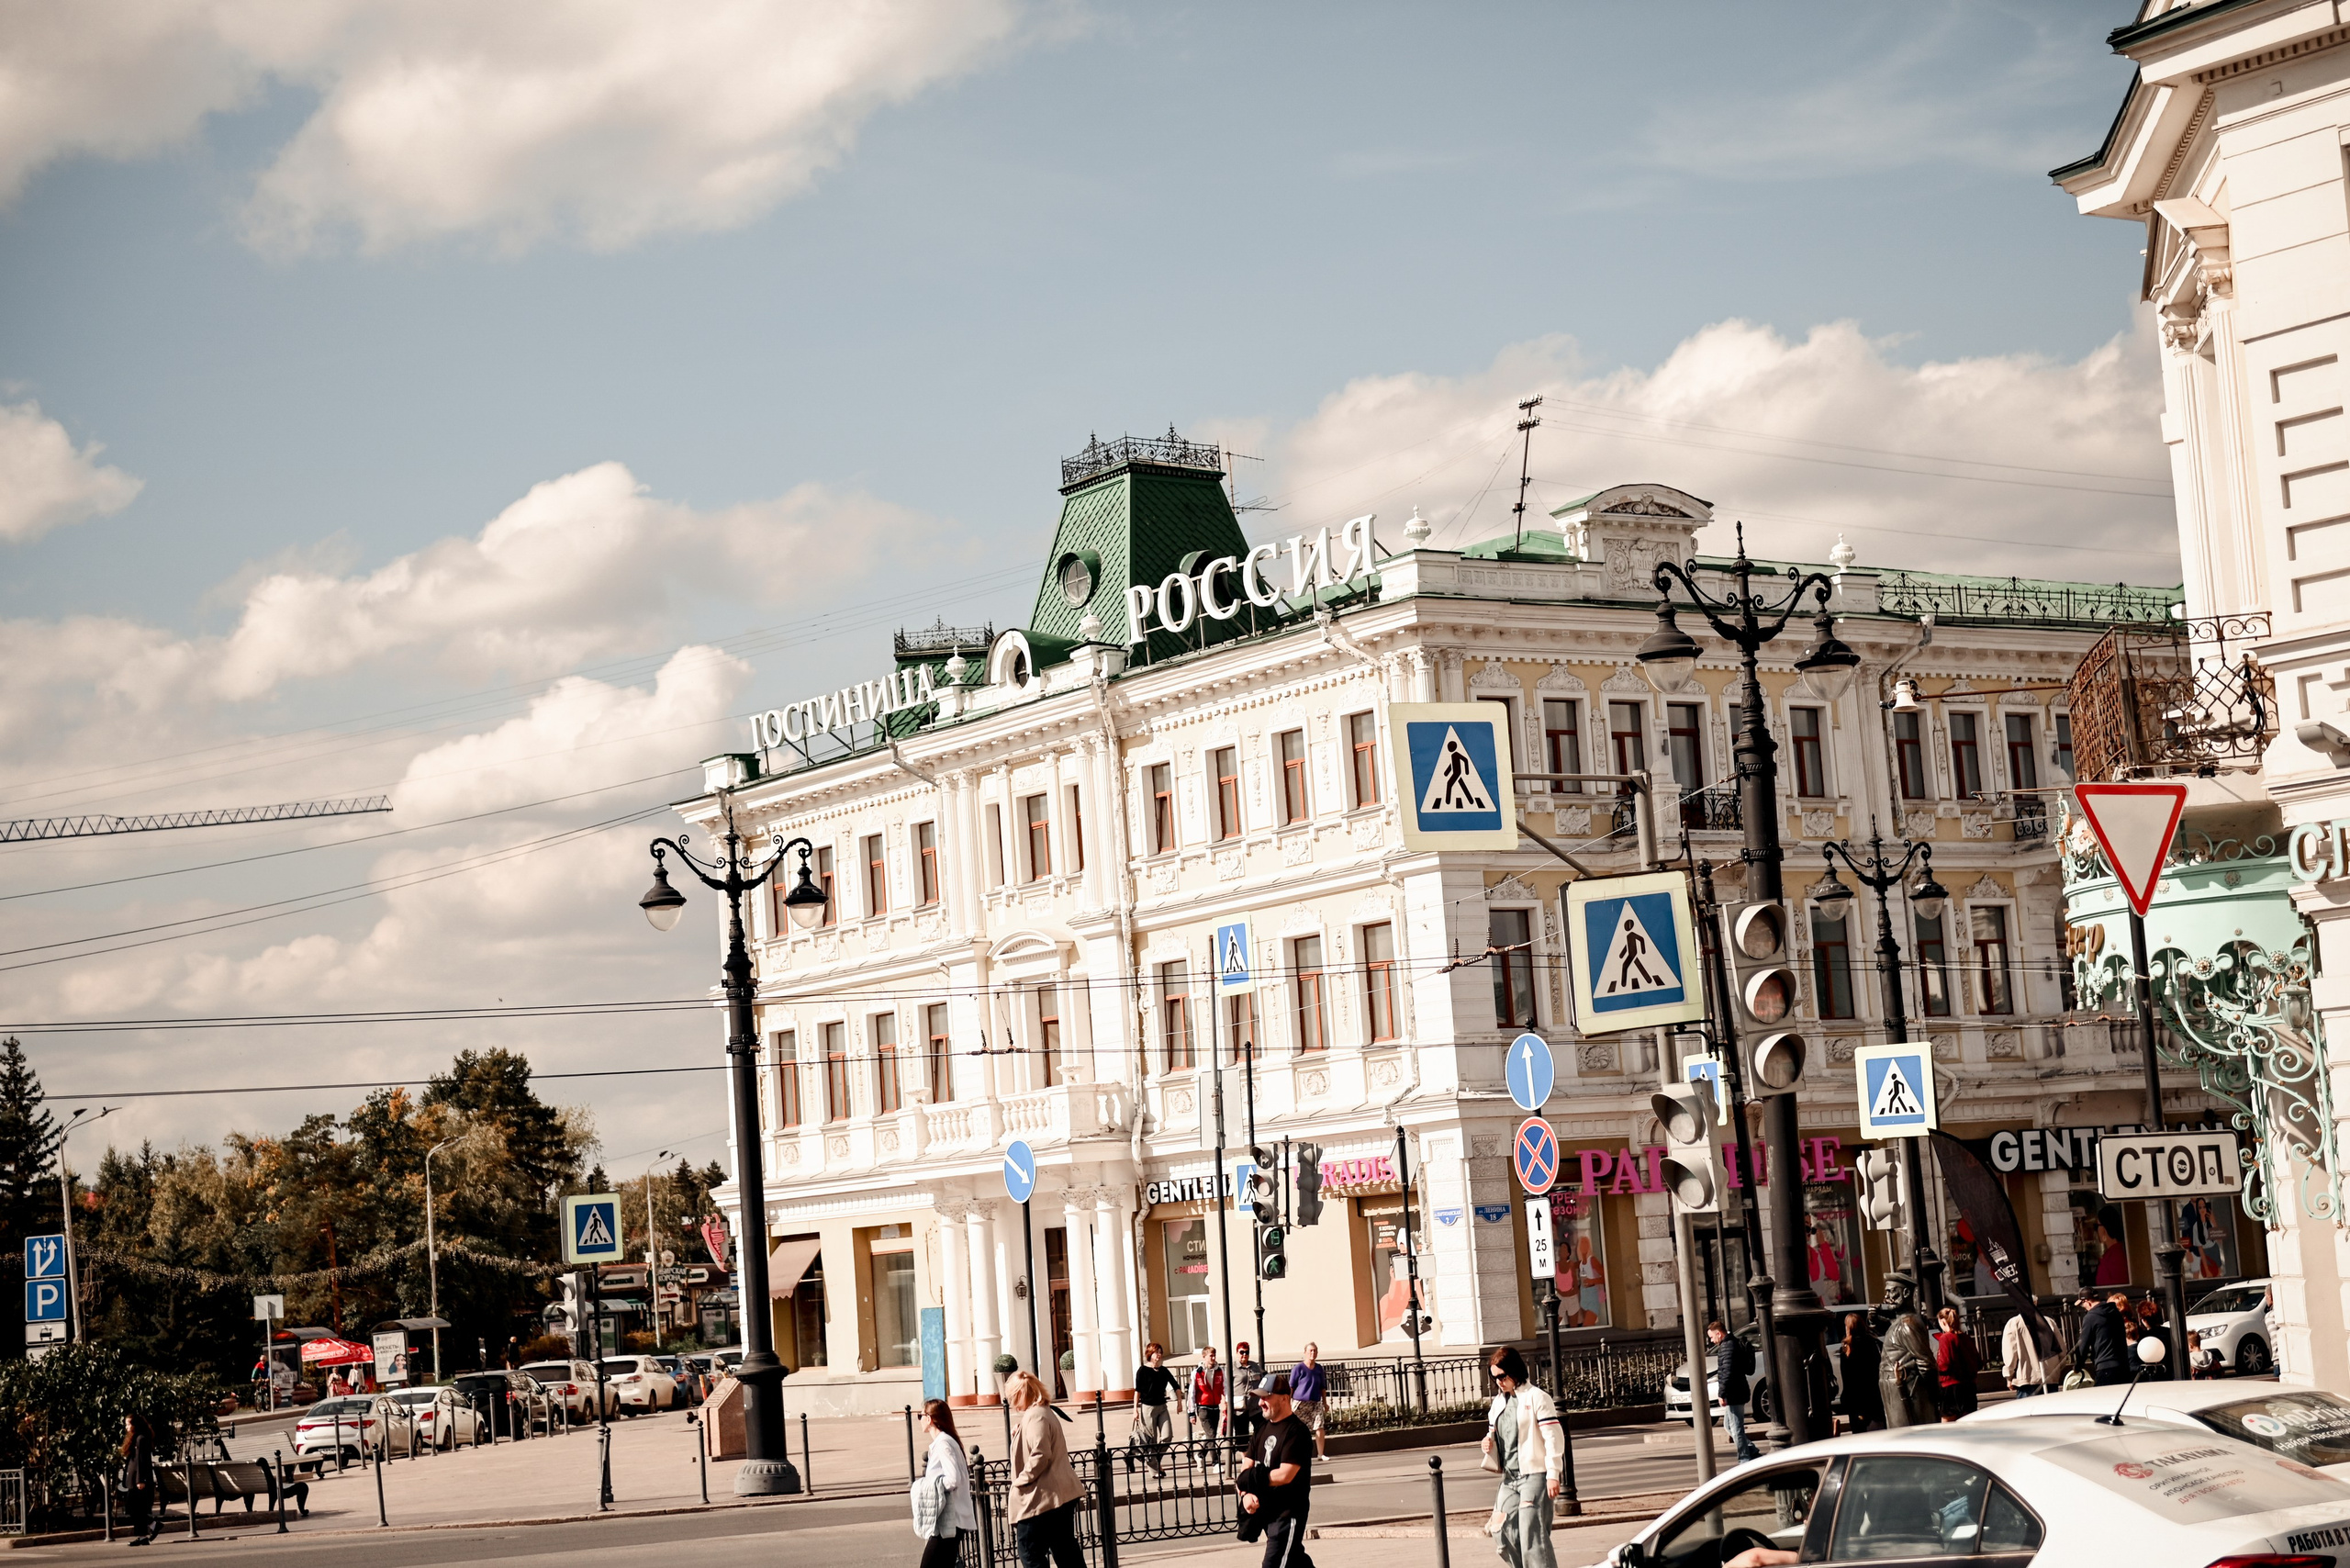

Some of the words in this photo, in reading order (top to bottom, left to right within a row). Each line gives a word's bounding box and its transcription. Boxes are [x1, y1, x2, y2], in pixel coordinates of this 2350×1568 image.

[1124, 513, 1378, 645] РОССИЯ
[749, 663, 938, 753] ГОСТИНИЦА
[2116, 1144, 2224, 1189] СТОП
[1186, 1239, 1206, 1252] СТИ
[1535, 1238, 1548, 1252] 25
[37, 1283, 59, 1317] P
[2303, 1422, 2329, 1431] Есть
[2276, 1435, 2312, 1451] Найди
[2143, 1448, 2236, 1468] TAKAYAMA
[2149, 1466, 2213, 1491] ОРИГИНАЛЬНОЕ
[2163, 1476, 2206, 1497] ЯПОНСКОЕ
[2177, 1493, 2198, 1505] ДЛЯ
[2287, 1529, 2336, 1553] РАБОТА
[2333, 1528, 2345, 1546] В
